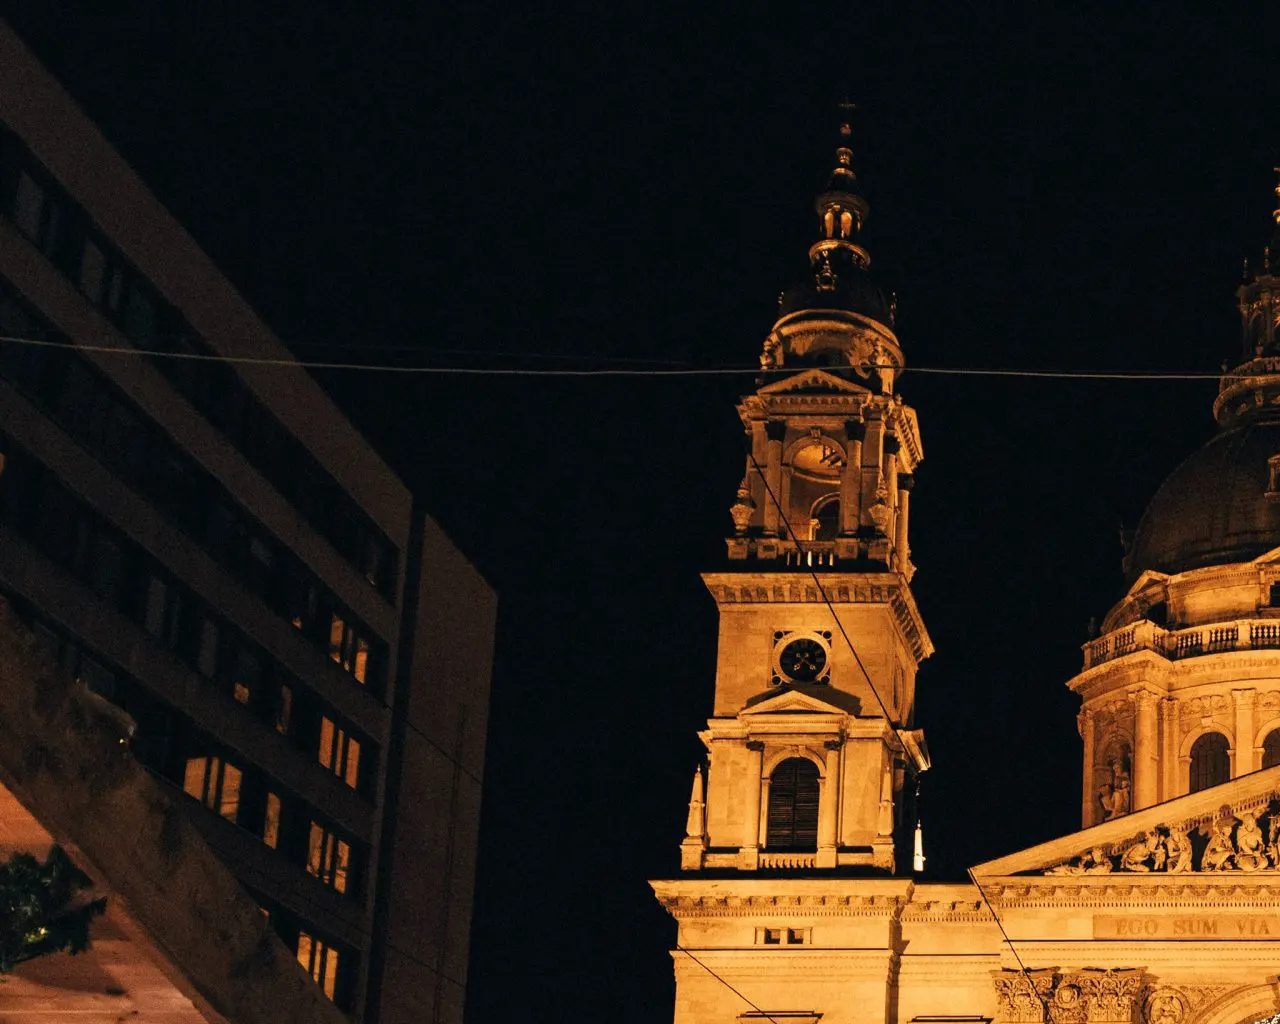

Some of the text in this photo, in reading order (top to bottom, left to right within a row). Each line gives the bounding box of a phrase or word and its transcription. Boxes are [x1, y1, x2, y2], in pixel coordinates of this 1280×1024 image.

[1114, 918, 1160, 936] EGO
[1172, 918, 1219, 935] SUM
[1235, 918, 1271, 935] VIA
